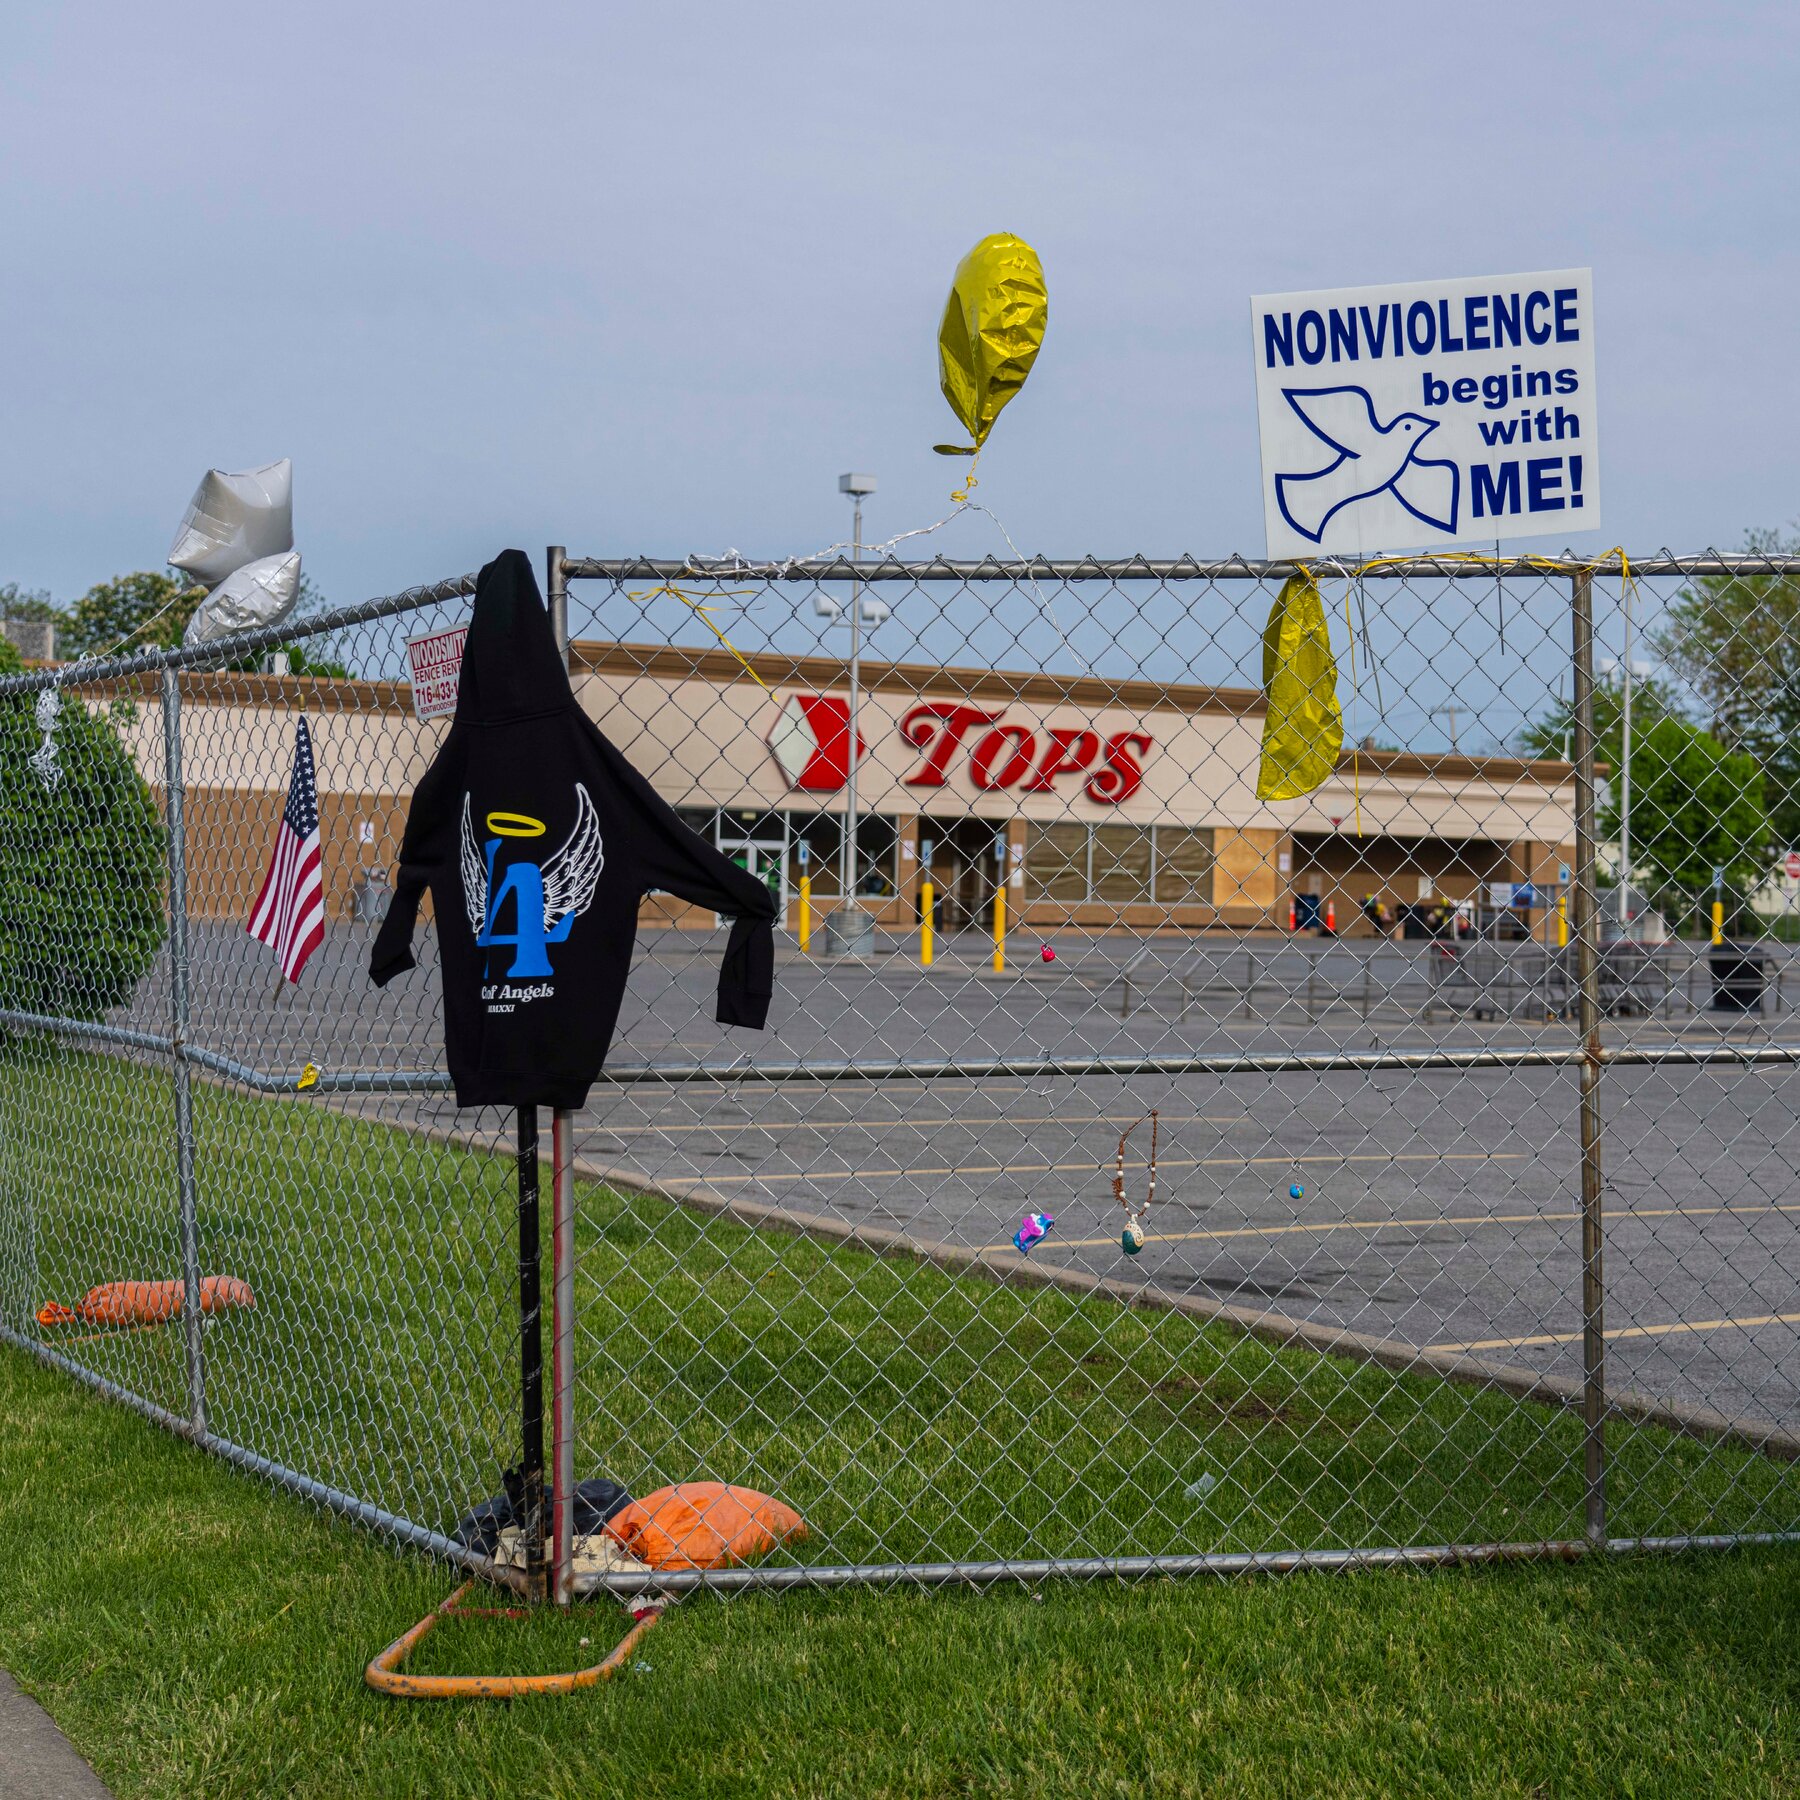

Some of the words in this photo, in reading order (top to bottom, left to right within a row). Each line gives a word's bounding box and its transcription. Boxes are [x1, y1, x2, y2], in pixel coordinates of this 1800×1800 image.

[1263, 288, 1580, 369] NONVIOLENCE
[1422, 364, 1579, 410] begins
[1478, 406, 1580, 447] with
[1470, 455, 1584, 518] ME!
[415, 666, 440, 684] FENCE
[498, 983, 555, 1003] Angels
